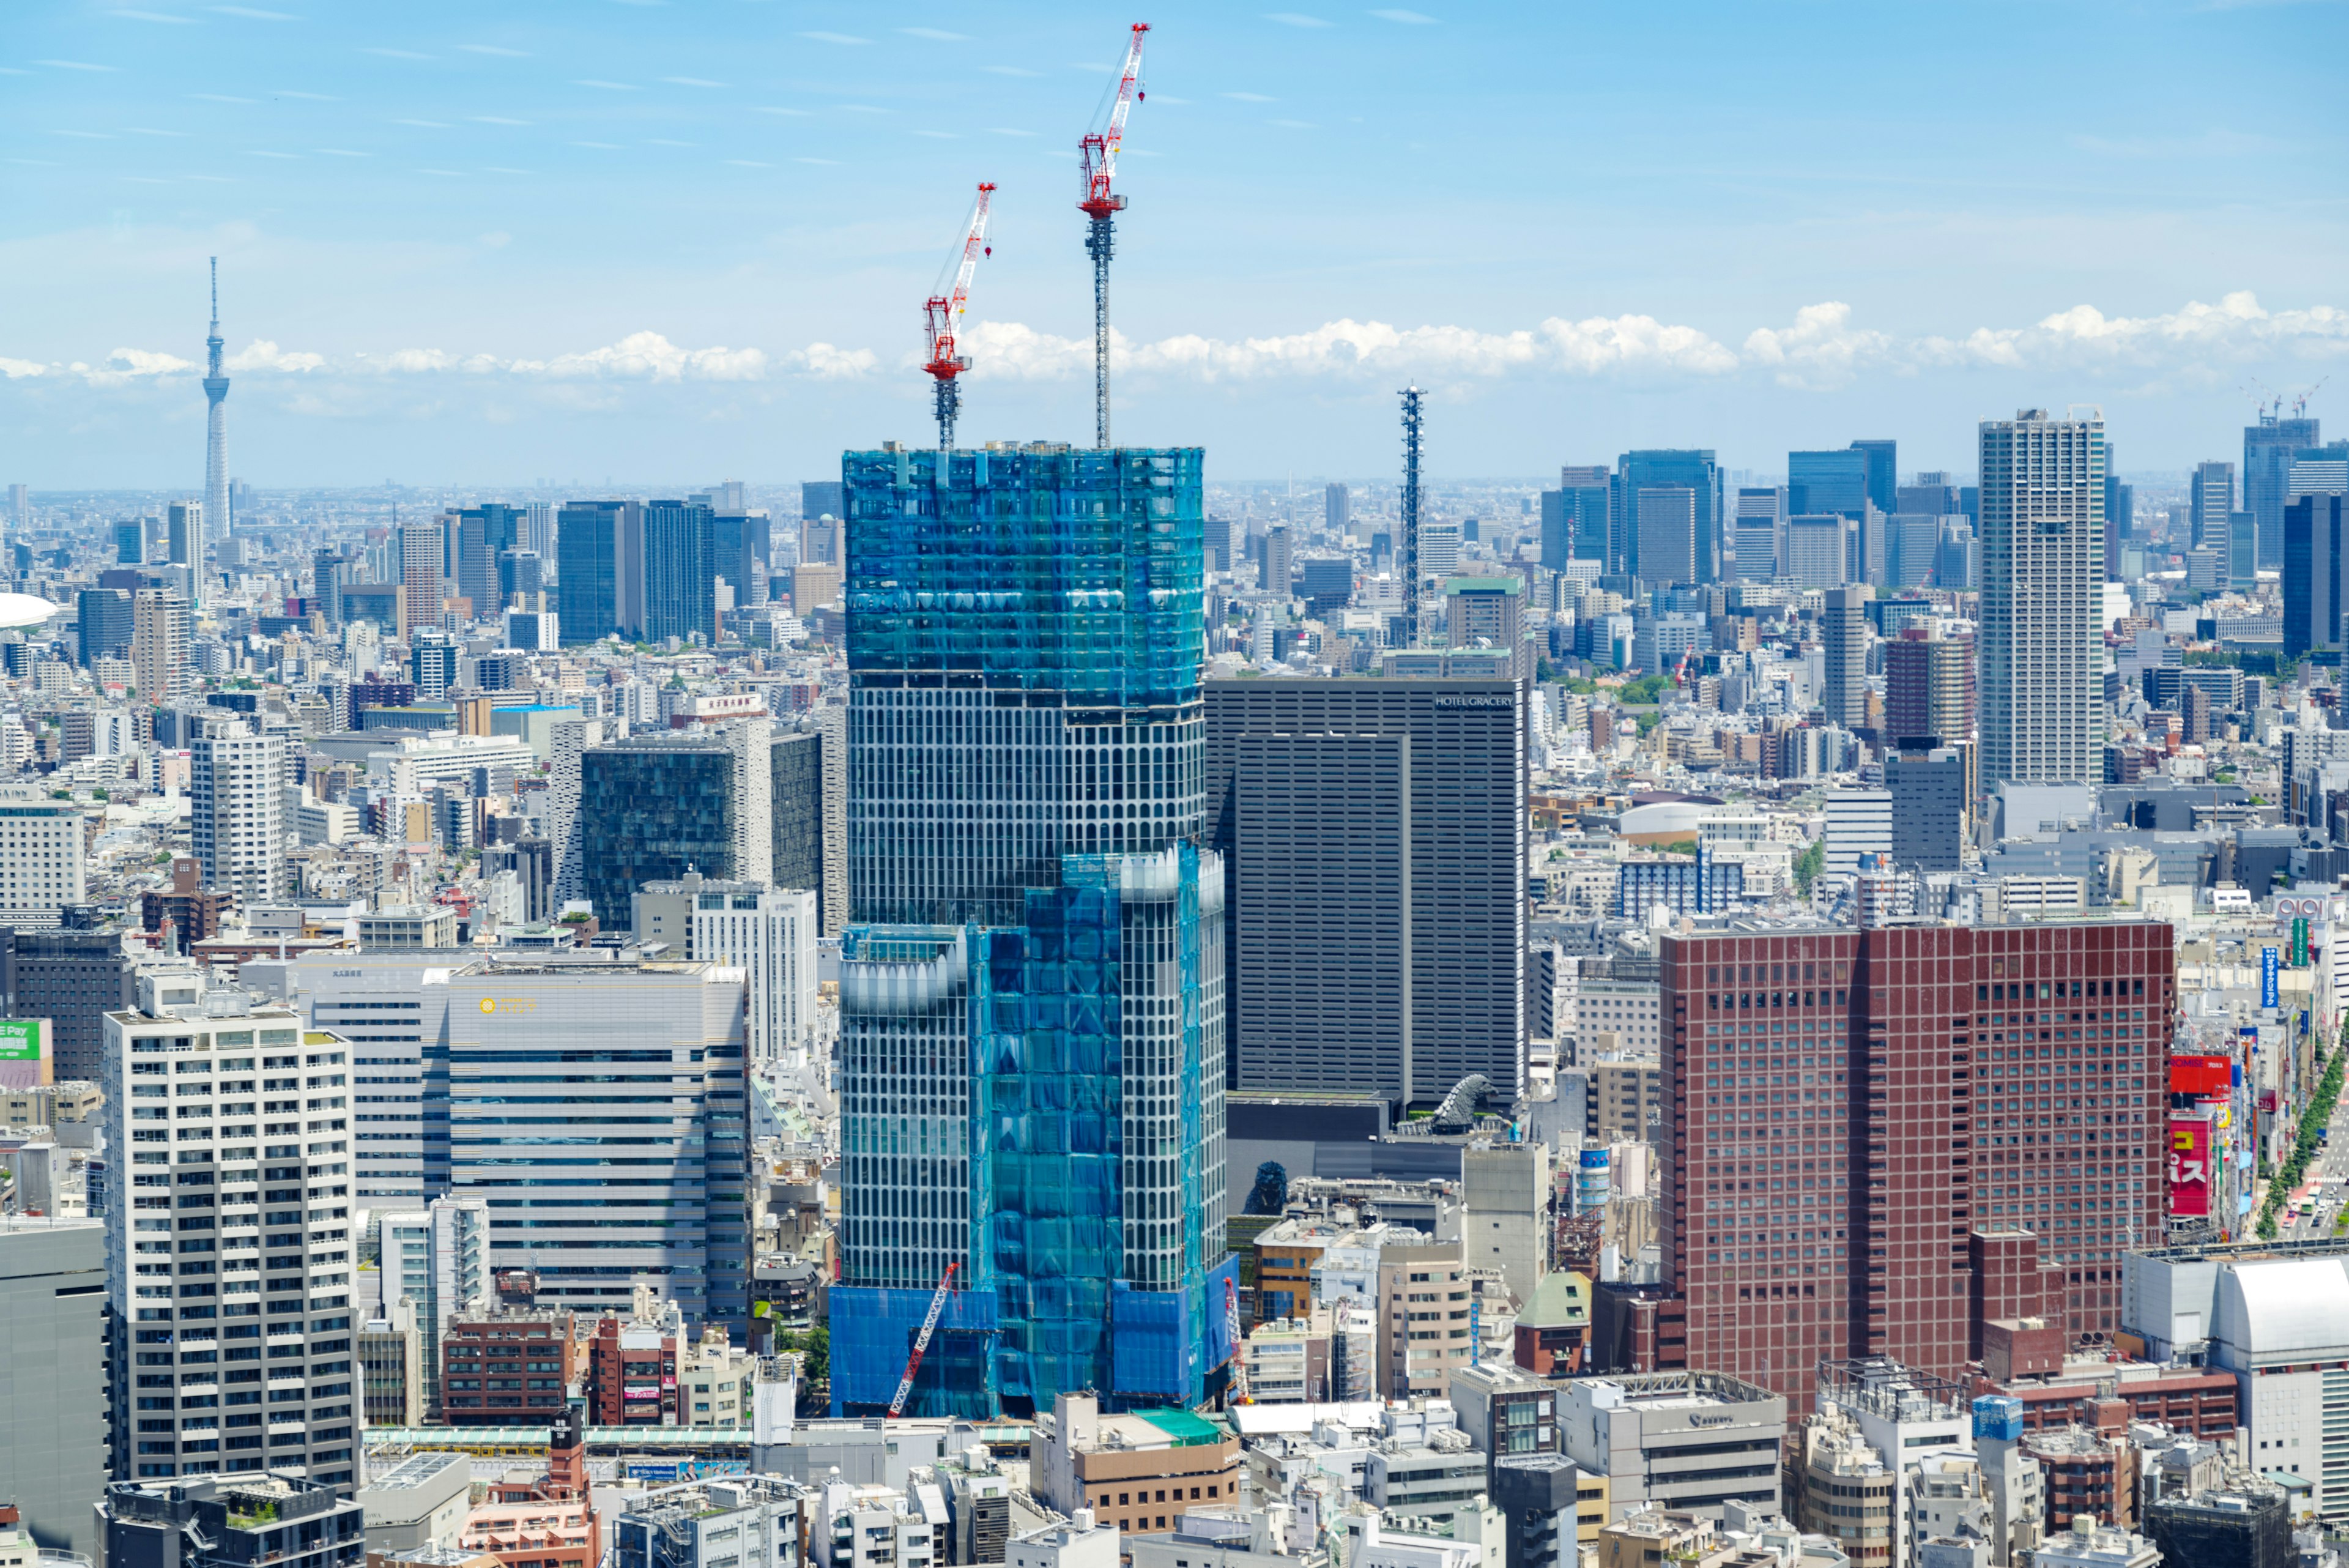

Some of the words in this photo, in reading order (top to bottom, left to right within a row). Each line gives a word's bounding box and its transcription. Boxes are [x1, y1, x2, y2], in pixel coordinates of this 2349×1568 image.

[1436, 697, 1467, 705] HOTEL
[1469, 697, 1513, 706] GRACERY
[12, 790, 27, 798] INN
[122, 962, 132, 974] APA
[7, 1026, 28, 1037] Pay
[2169, 1058, 2204, 1068] ROMISE
[1565, 1082, 1575, 1097] P
